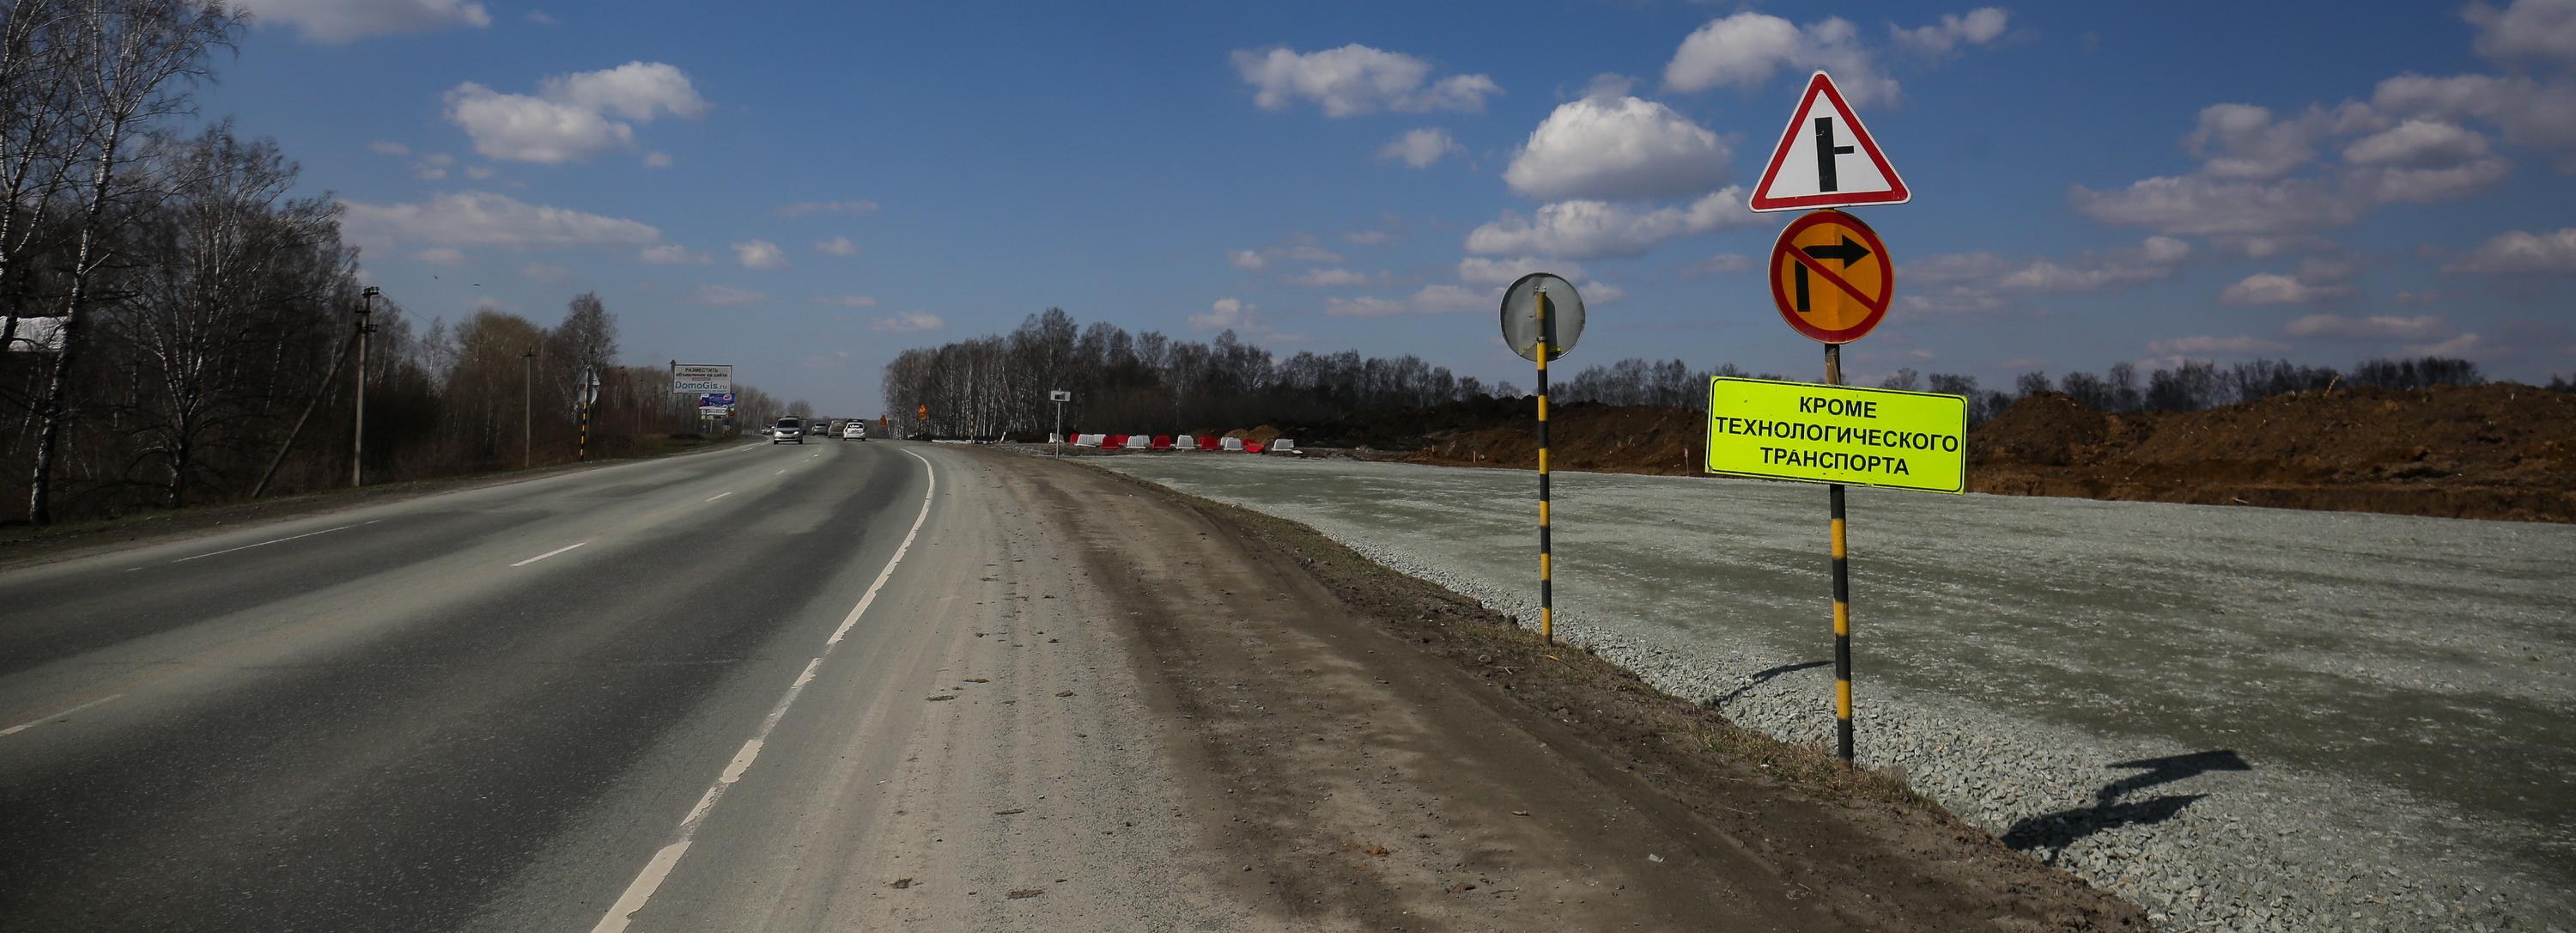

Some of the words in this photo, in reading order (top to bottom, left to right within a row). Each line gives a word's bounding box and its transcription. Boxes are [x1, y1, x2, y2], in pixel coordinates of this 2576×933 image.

[1799, 396, 1878, 419] КРОМЕ
[1715, 416, 1959, 453] ТЕХНОЛОГИЧЕСКОГО
[1760, 446, 1911, 476] ТРАНСПОРТА
